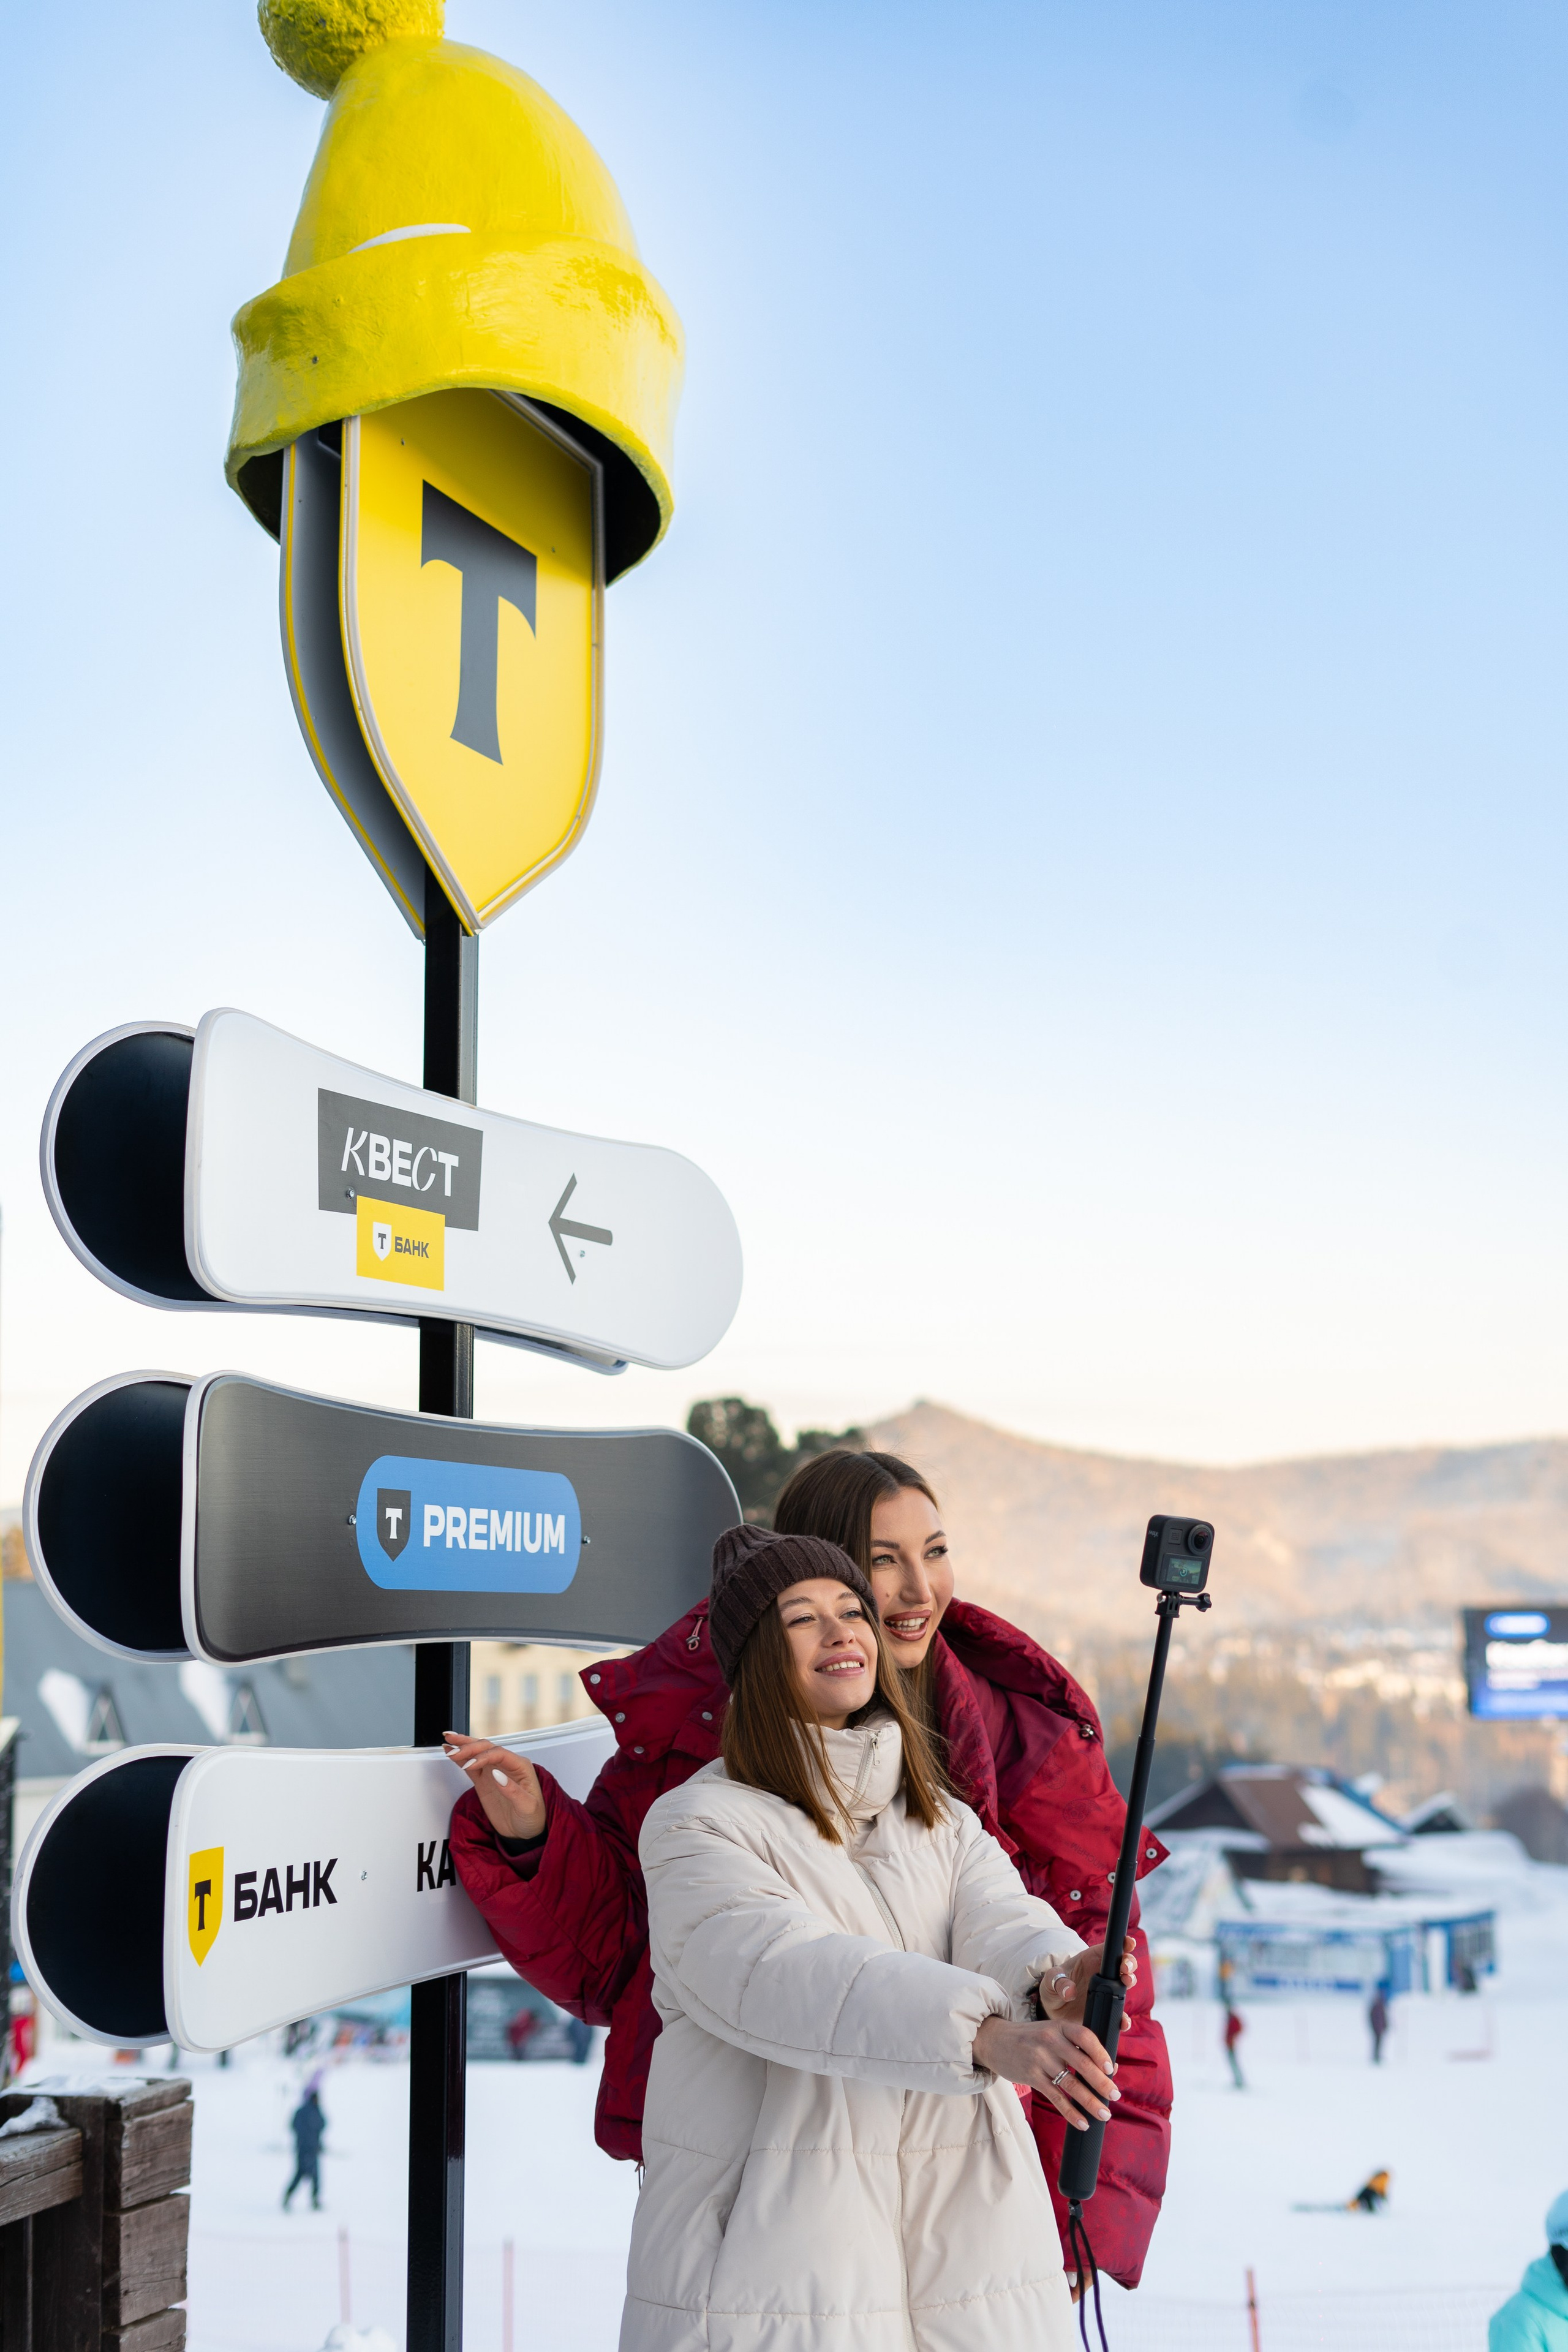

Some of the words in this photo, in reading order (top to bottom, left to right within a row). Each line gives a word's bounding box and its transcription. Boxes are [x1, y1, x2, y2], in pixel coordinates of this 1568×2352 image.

[341, 1126, 459, 1197] КВЕСТ
[395, 1236, 429, 1259] БАНК
[423, 1504, 565, 1554] PREMIUM
[234, 1858, 338, 1922] БАНК
